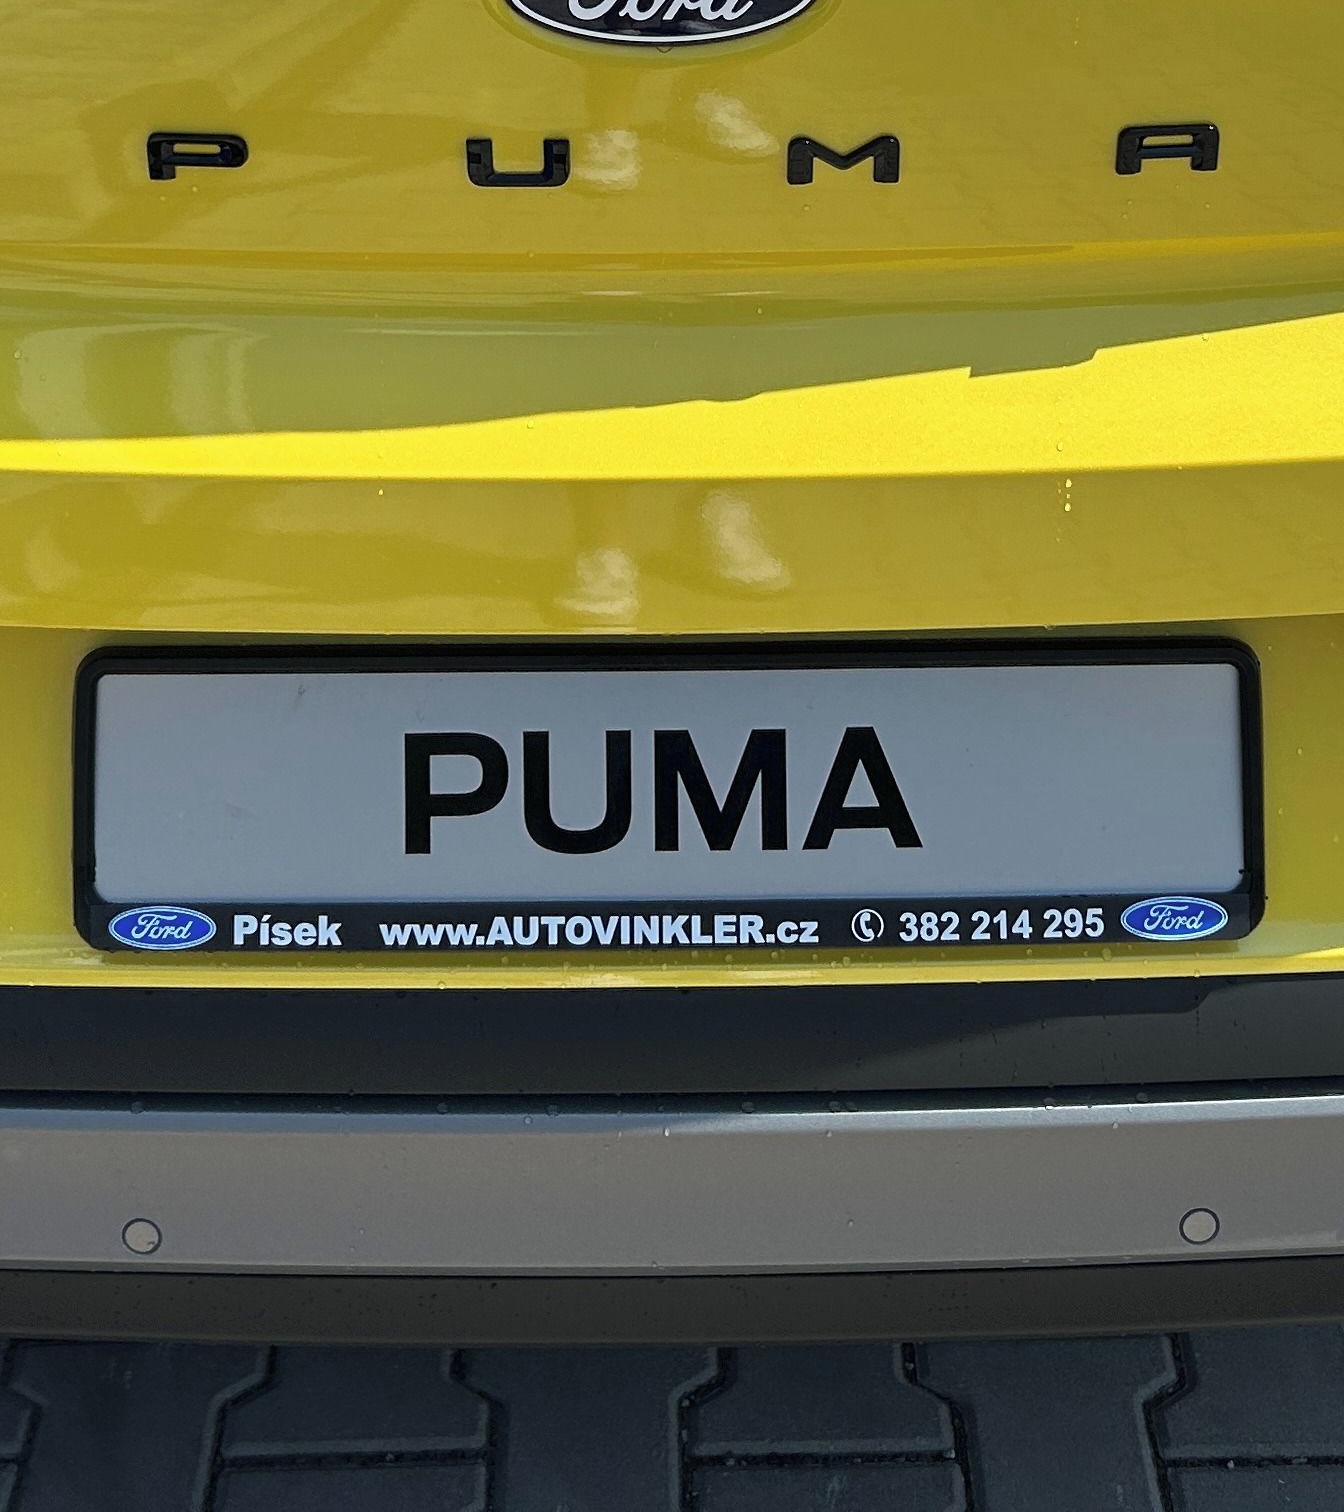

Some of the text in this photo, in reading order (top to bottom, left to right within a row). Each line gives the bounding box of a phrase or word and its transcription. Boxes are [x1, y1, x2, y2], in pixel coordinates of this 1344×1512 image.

[147, 123, 1220, 188] PUMA
[404, 726, 924, 855] PUMA
[131, 913, 194, 940] Ford
[233, 907, 1105, 946] Písek www.AUTOVINKLER.cz 382 214 295
[1142, 904, 1204, 931] Ford
